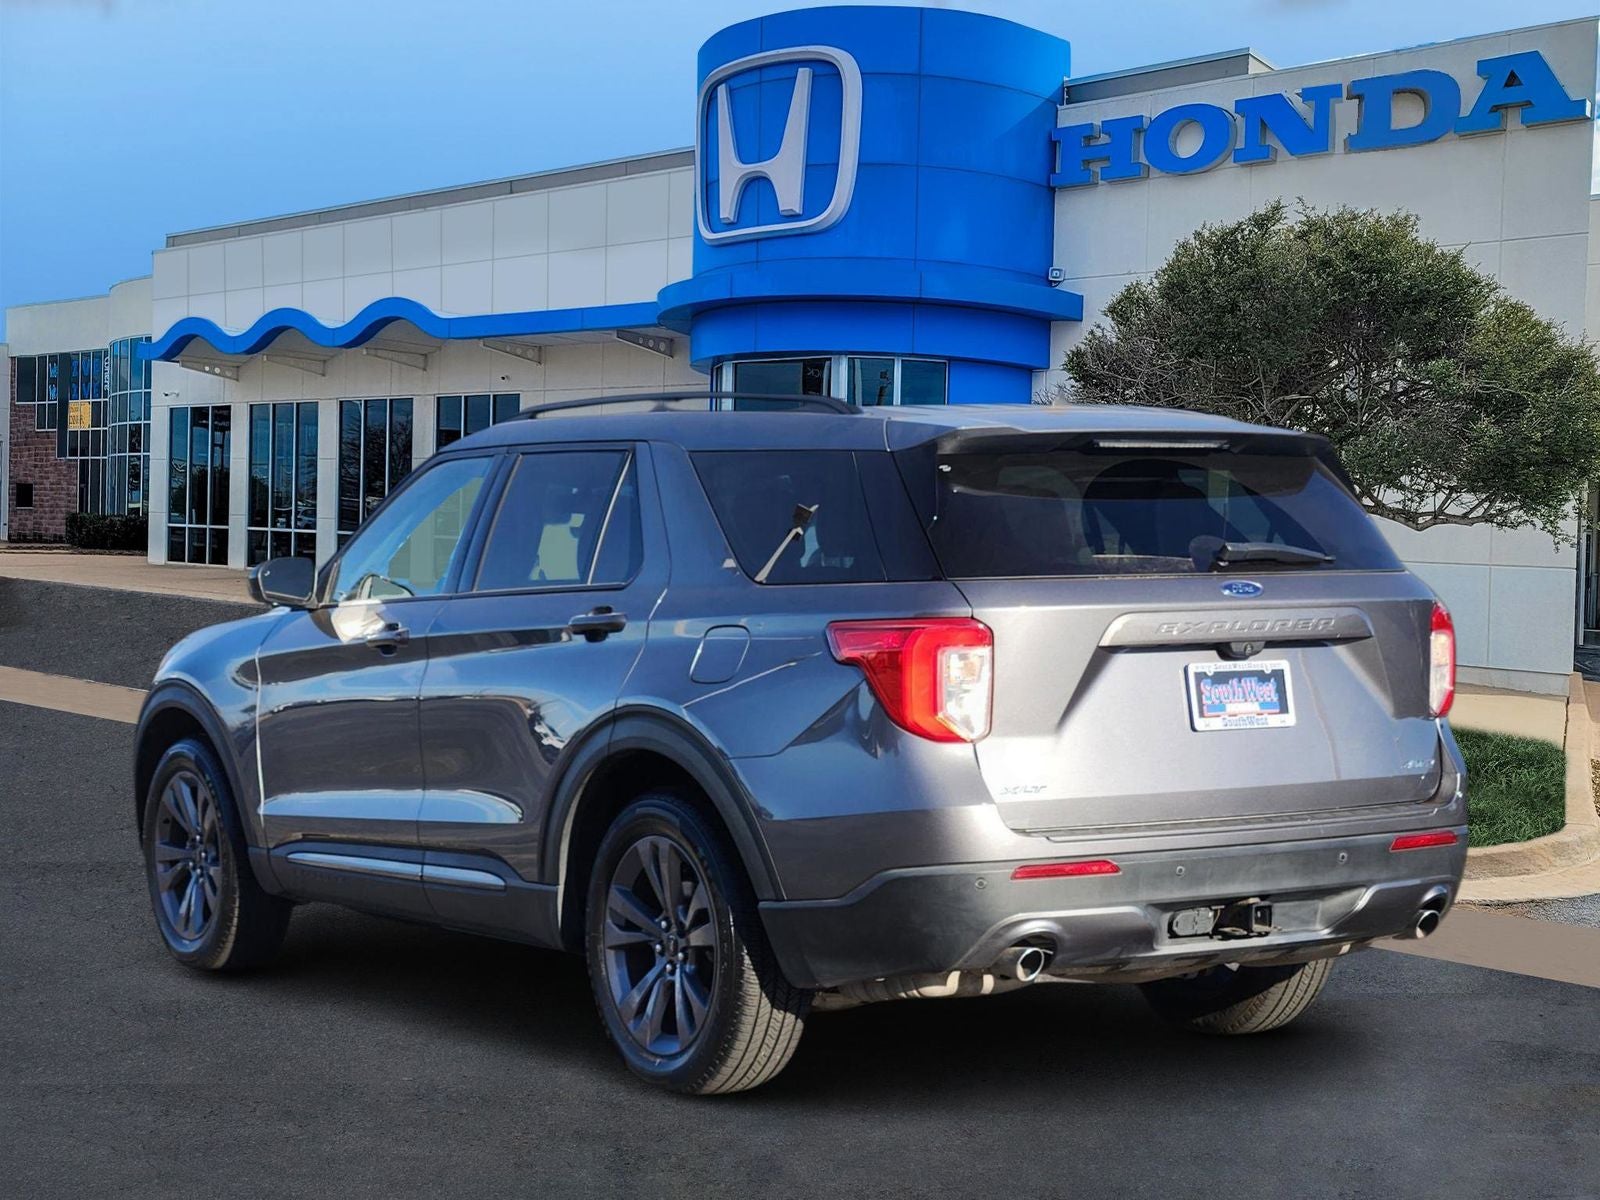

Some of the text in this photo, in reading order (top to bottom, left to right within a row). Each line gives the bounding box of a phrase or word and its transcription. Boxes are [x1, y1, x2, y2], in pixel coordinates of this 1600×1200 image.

[1051, 50, 1591, 188] HONDA
[1155, 617, 1336, 636] EXPLORER
[1221, 716, 1271, 727] SouthWest
[999, 784, 1047, 796] XLT
